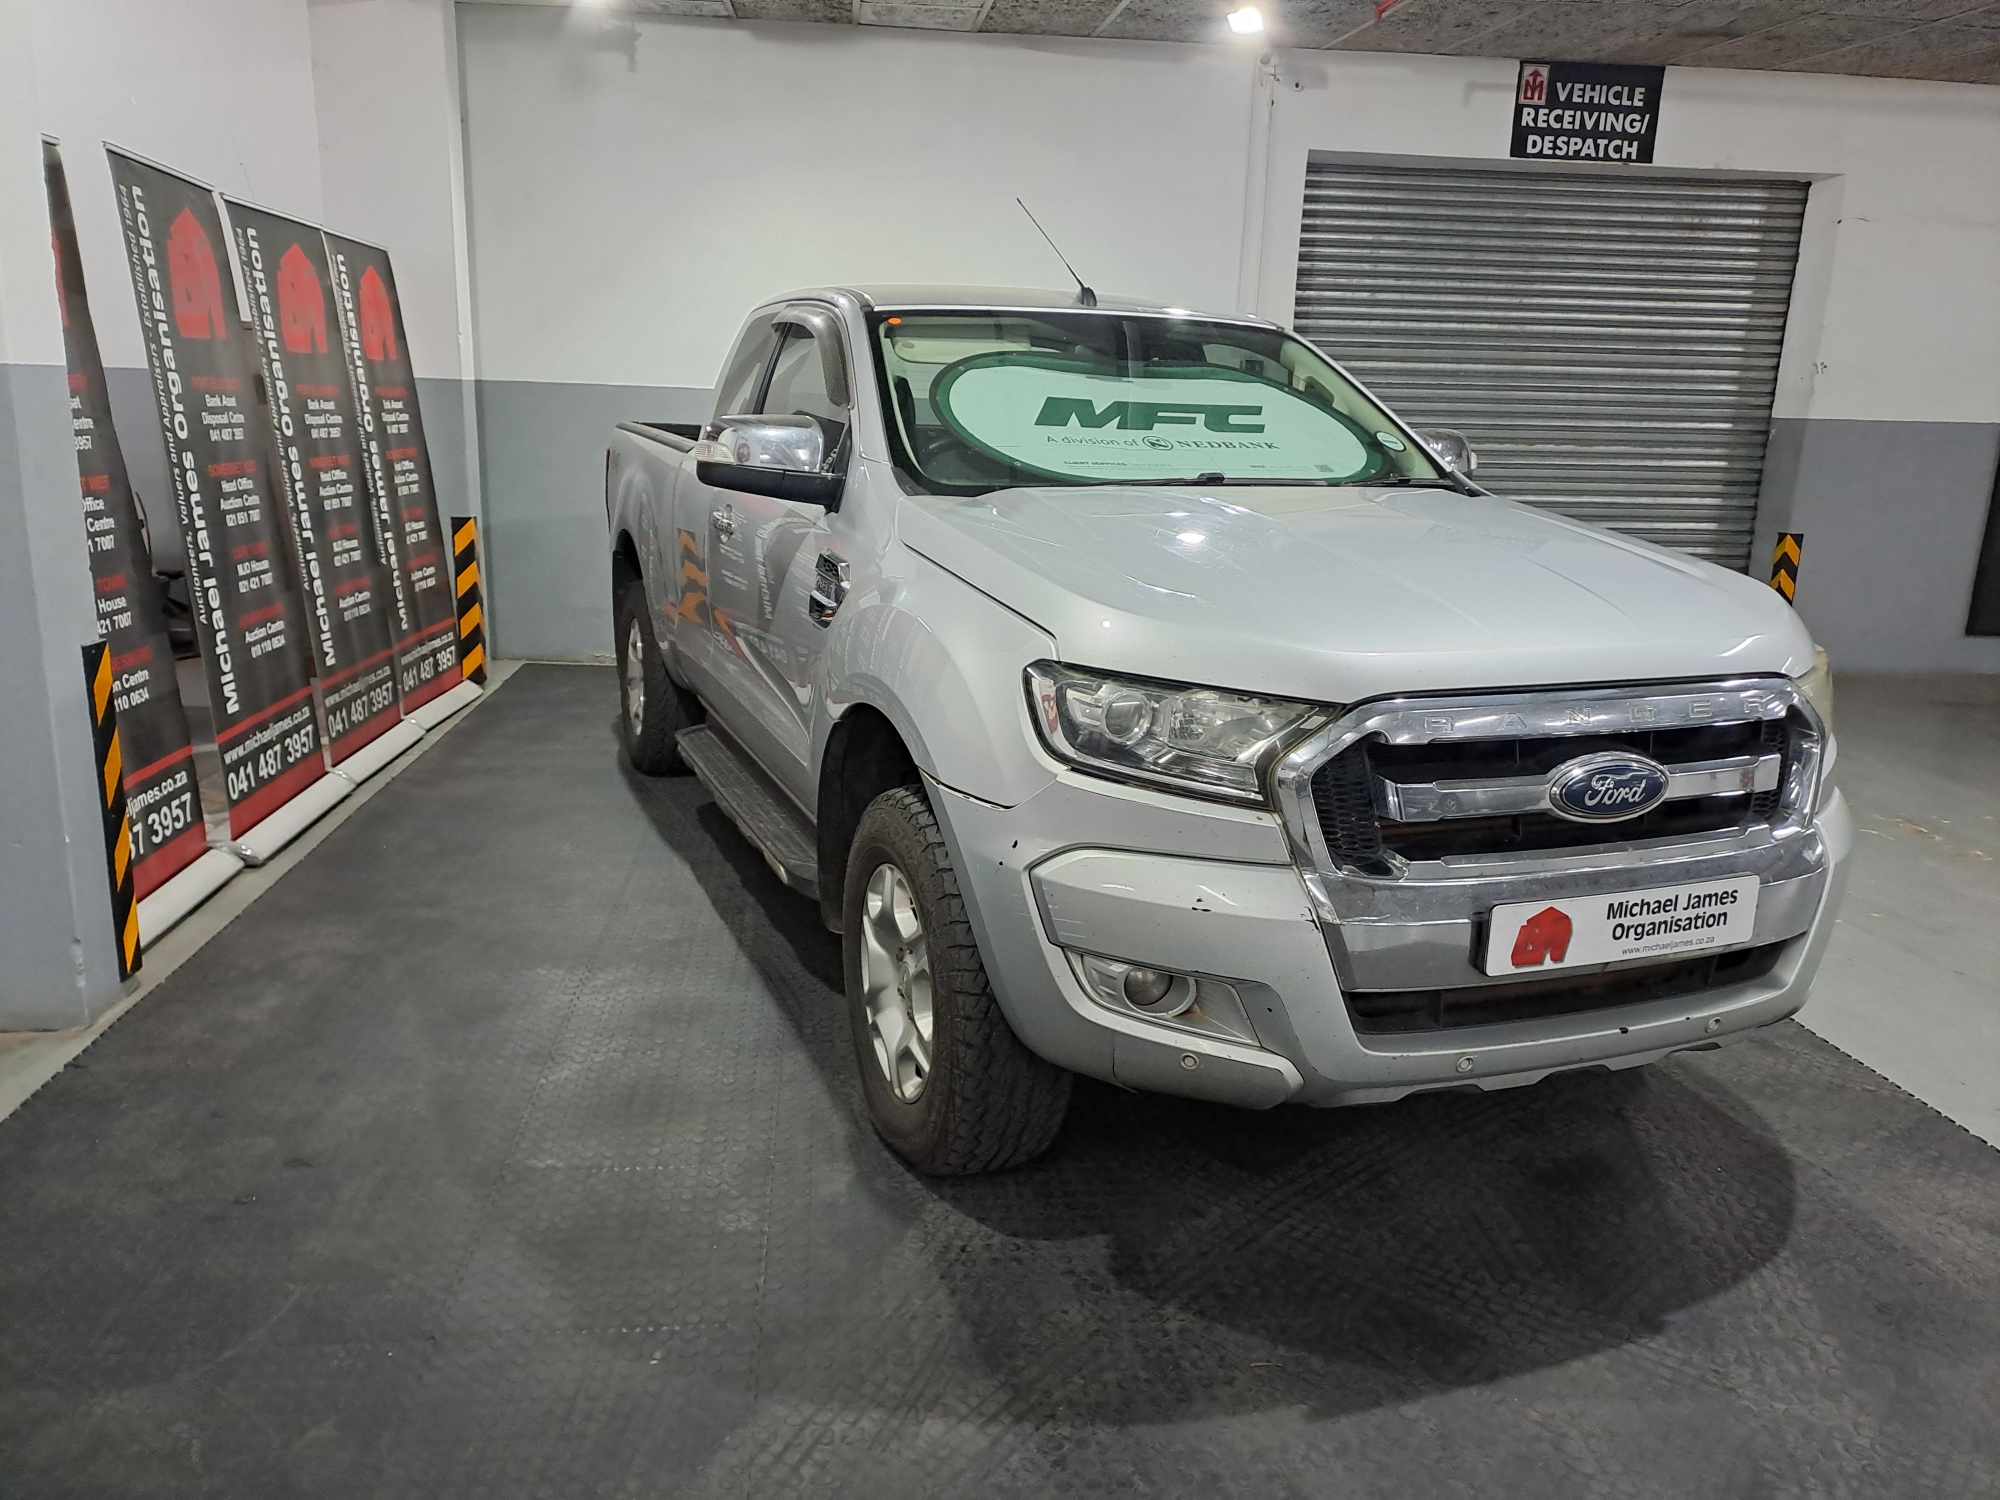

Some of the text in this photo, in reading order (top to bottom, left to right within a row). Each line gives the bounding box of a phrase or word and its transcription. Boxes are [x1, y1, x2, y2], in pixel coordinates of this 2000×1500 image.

[1556, 82, 1646, 107] VEHICLE
[1521, 107, 1650, 135] RECEIVING/
[1526, 135, 1638, 160] DESPATCH
[119, 184, 133, 226] 1964
[127, 230, 152, 327] Established
[336, 254, 374, 432] Organisation
[150, 343, 172, 428] Appraisers
[73, 416, 94, 430] entre
[1034, 396, 1266, 433] MFC
[131, 185, 240, 715] Michael James Organisation
[165, 431, 178, 464] and
[246, 227, 336, 667] Michael James Organisation
[1061, 434, 1120, 447] division
[1122, 437, 1139, 447] of
[1176, 439, 1281, 450] NEDBANK
[173, 467, 189, 524] Valuers
[369, 440, 391, 525] James
[87, 516, 115, 532] Centre
[185, 531, 208, 624] Auctioneers,
[383, 531, 409, 631] Michael
[97, 595, 128, 614] House
[402, 645, 457, 692] 041 487 3957
[327, 681, 394, 738] 041 487 3957
[1424, 698, 1767, 734] RANGER
[223, 706, 311, 765] www.michaeljames.co.za
[227, 724, 315, 800] 041 487 3957
[1586, 771, 1648, 807] Ford
[147, 792, 192, 845] 3957
[1605, 888, 1739, 921] Michael James
[1612, 909, 1729, 942] Organisation
[1621, 935, 1716, 956] www.michaeljames.co.za
